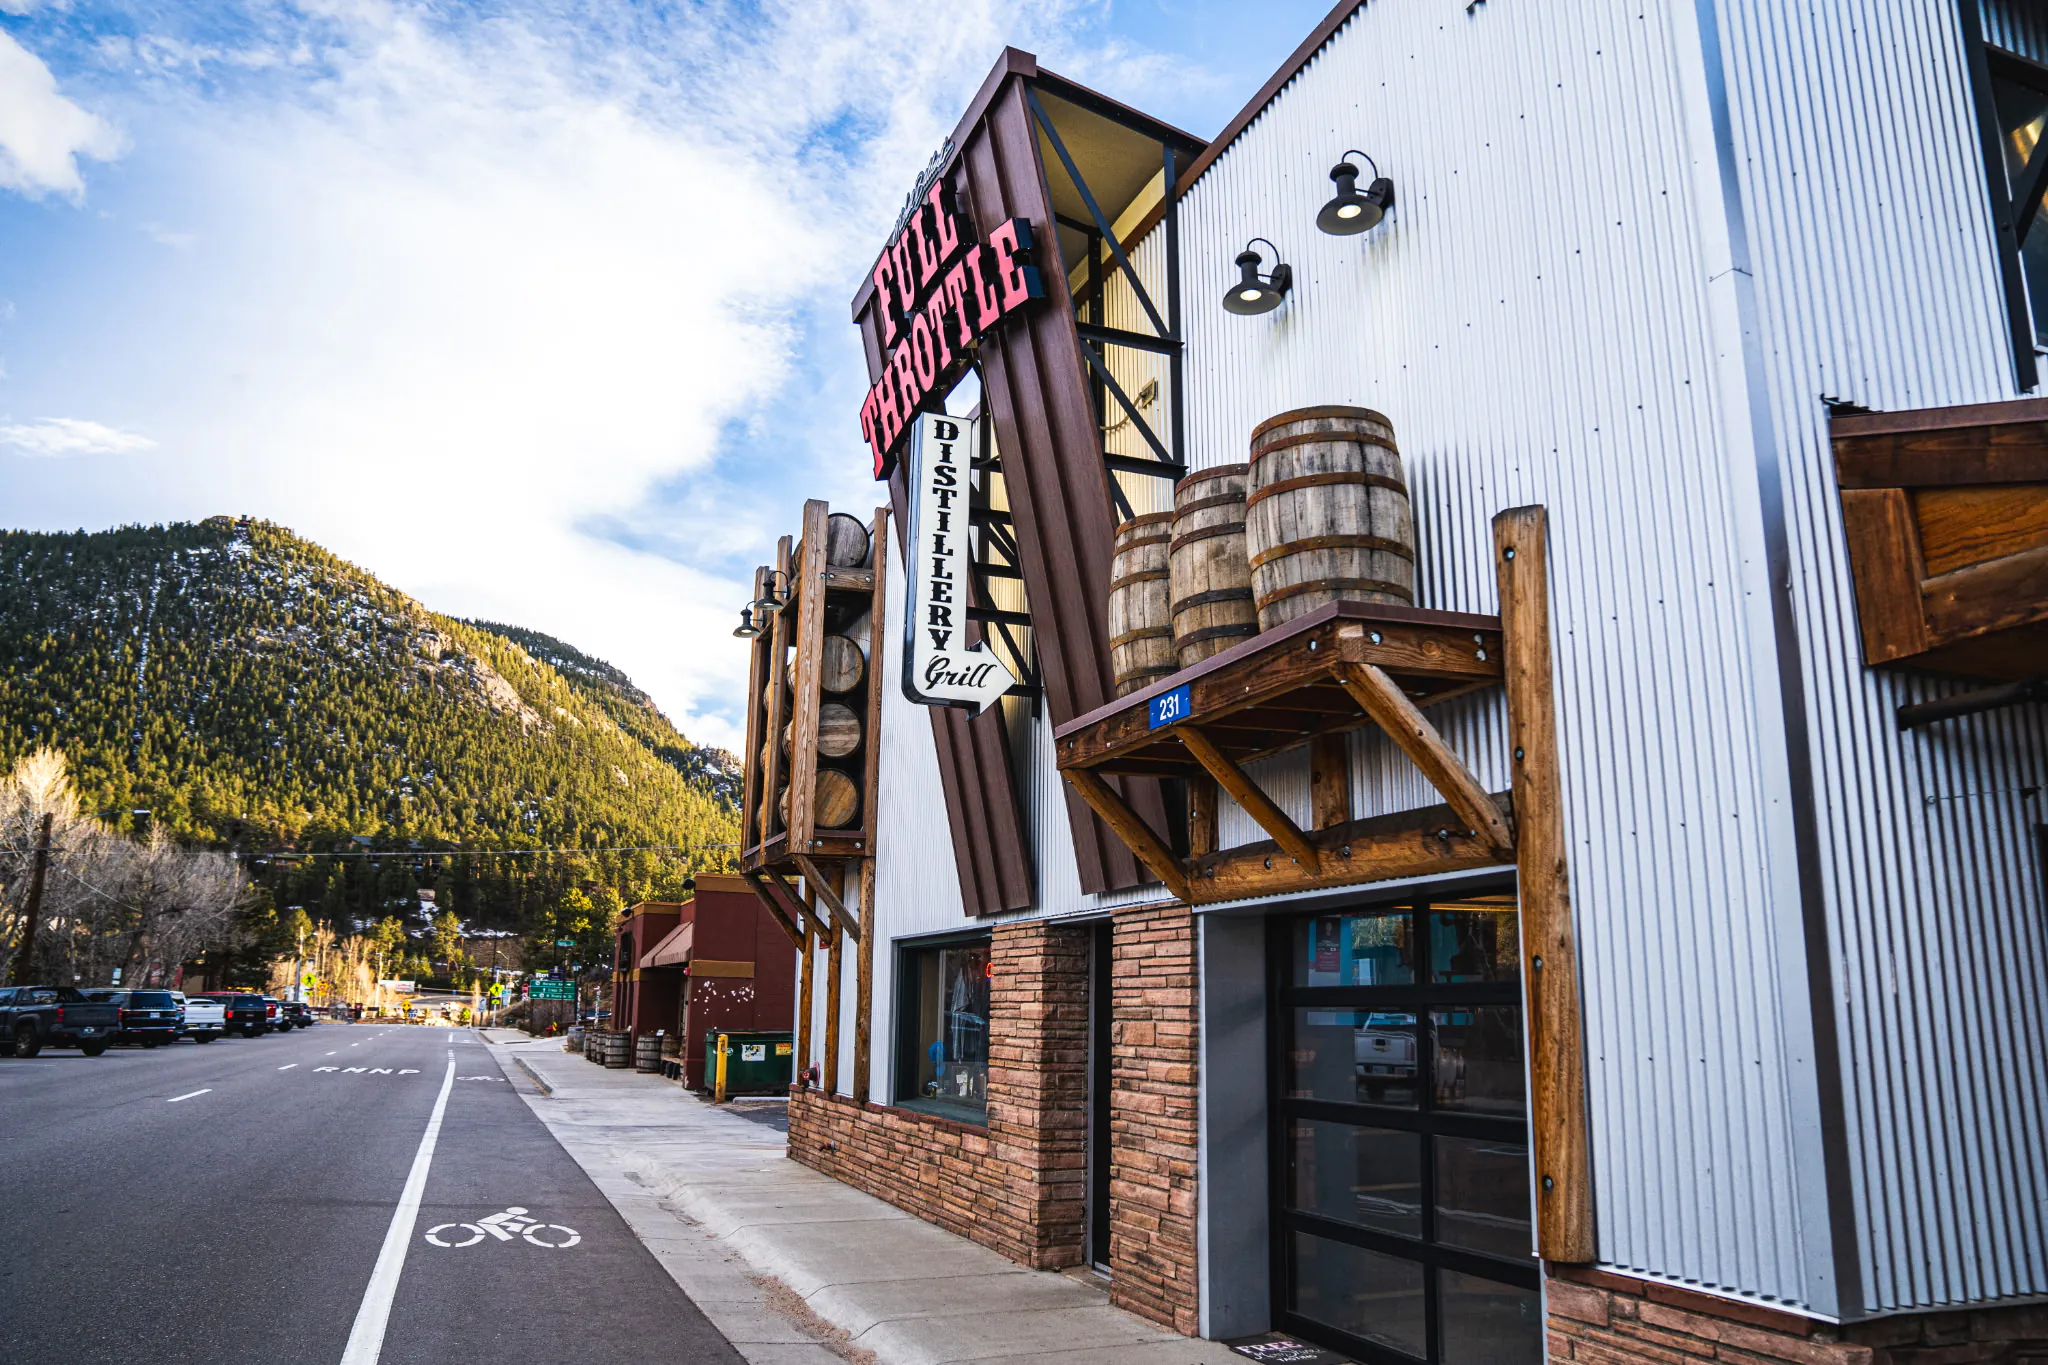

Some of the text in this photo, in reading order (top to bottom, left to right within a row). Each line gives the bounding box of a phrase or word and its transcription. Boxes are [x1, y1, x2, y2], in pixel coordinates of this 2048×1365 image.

[872, 177, 960, 349] FULL
[859, 217, 1031, 480] THROTTLE
[927, 419, 961, 652] DISTILLERY
[924, 654, 998, 691] Grill
[1159, 693, 1180, 721] 231
[311, 1065, 422, 1076] RMNP
